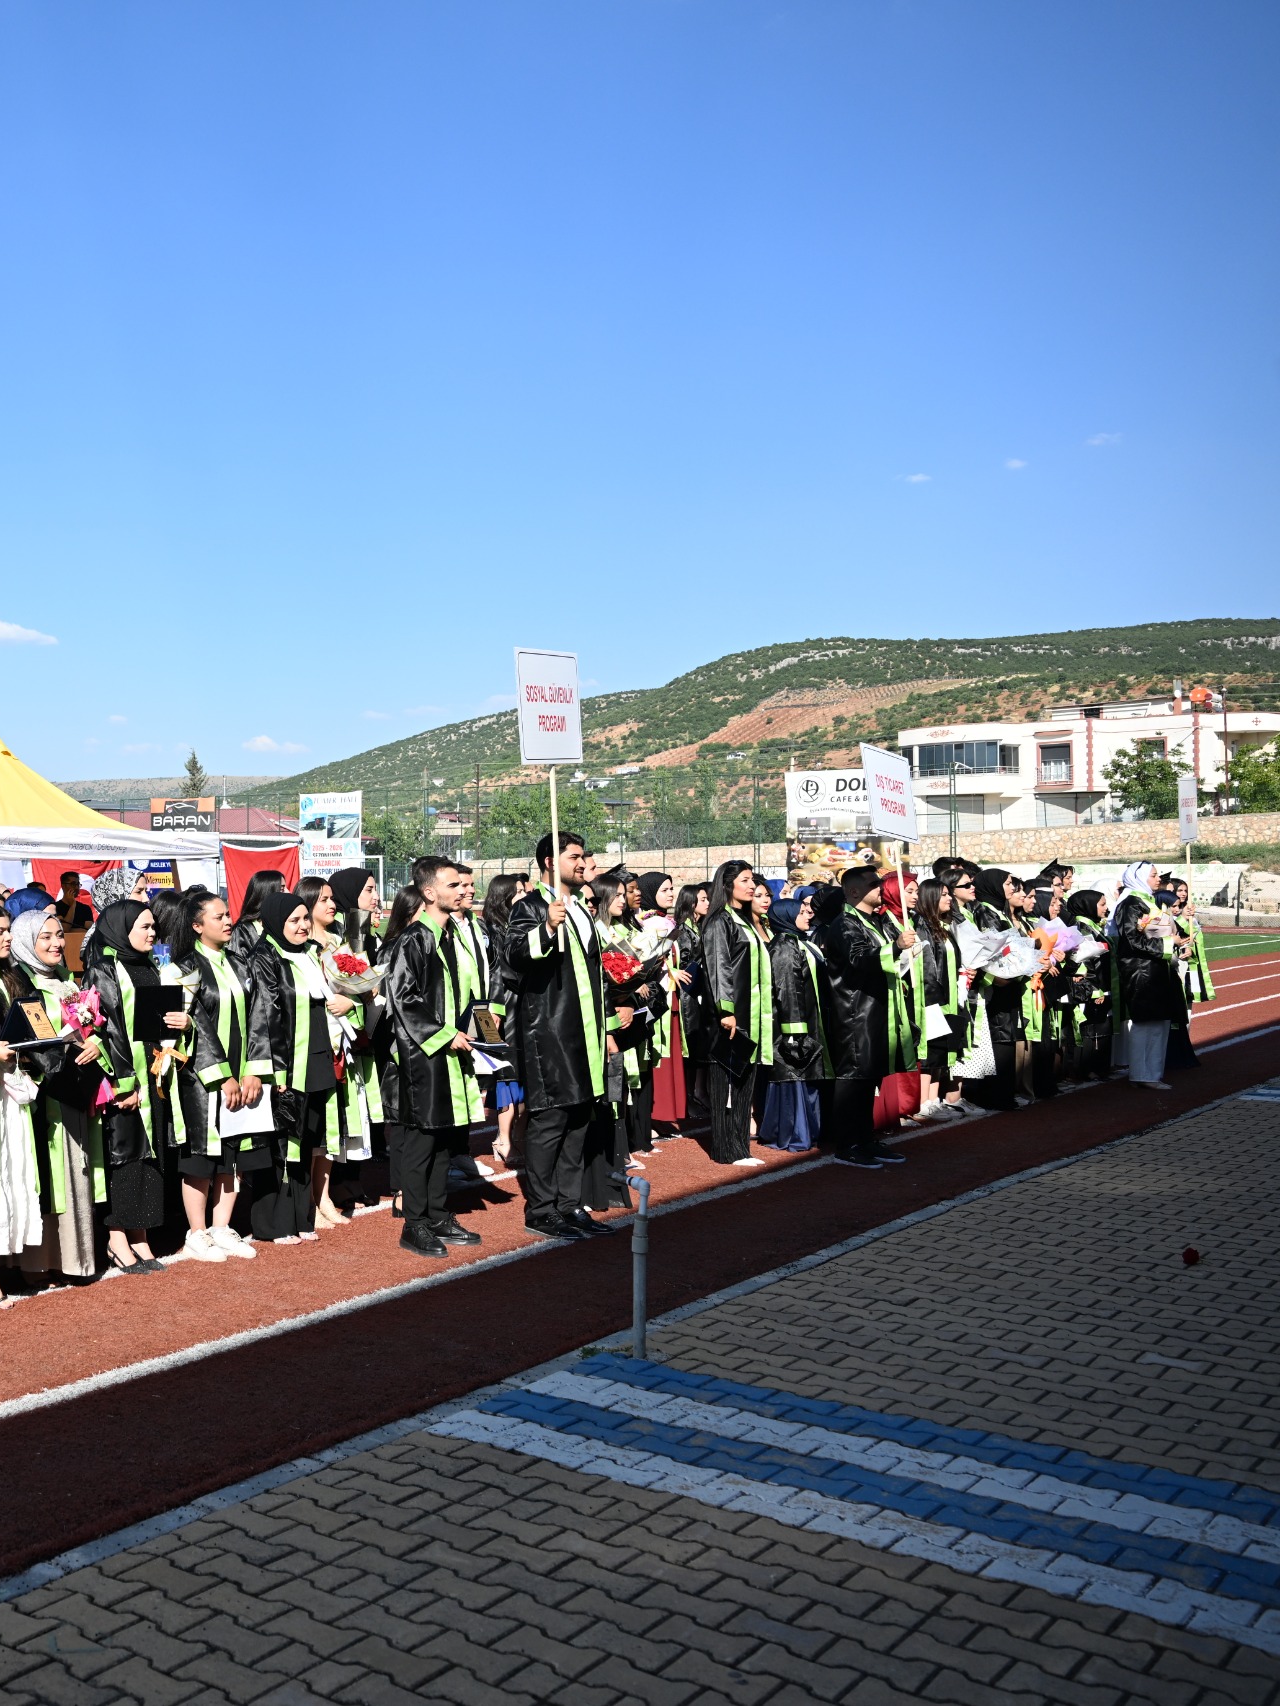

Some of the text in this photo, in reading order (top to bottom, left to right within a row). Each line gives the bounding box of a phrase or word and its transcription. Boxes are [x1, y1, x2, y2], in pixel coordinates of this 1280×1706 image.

[526, 683, 574, 704] SOSYAL GÜVENLİK
[875, 773, 905, 796] DIŞ TİCARET
[830, 795, 852, 803] CAFE
[153, 814, 211, 827] BARAN
